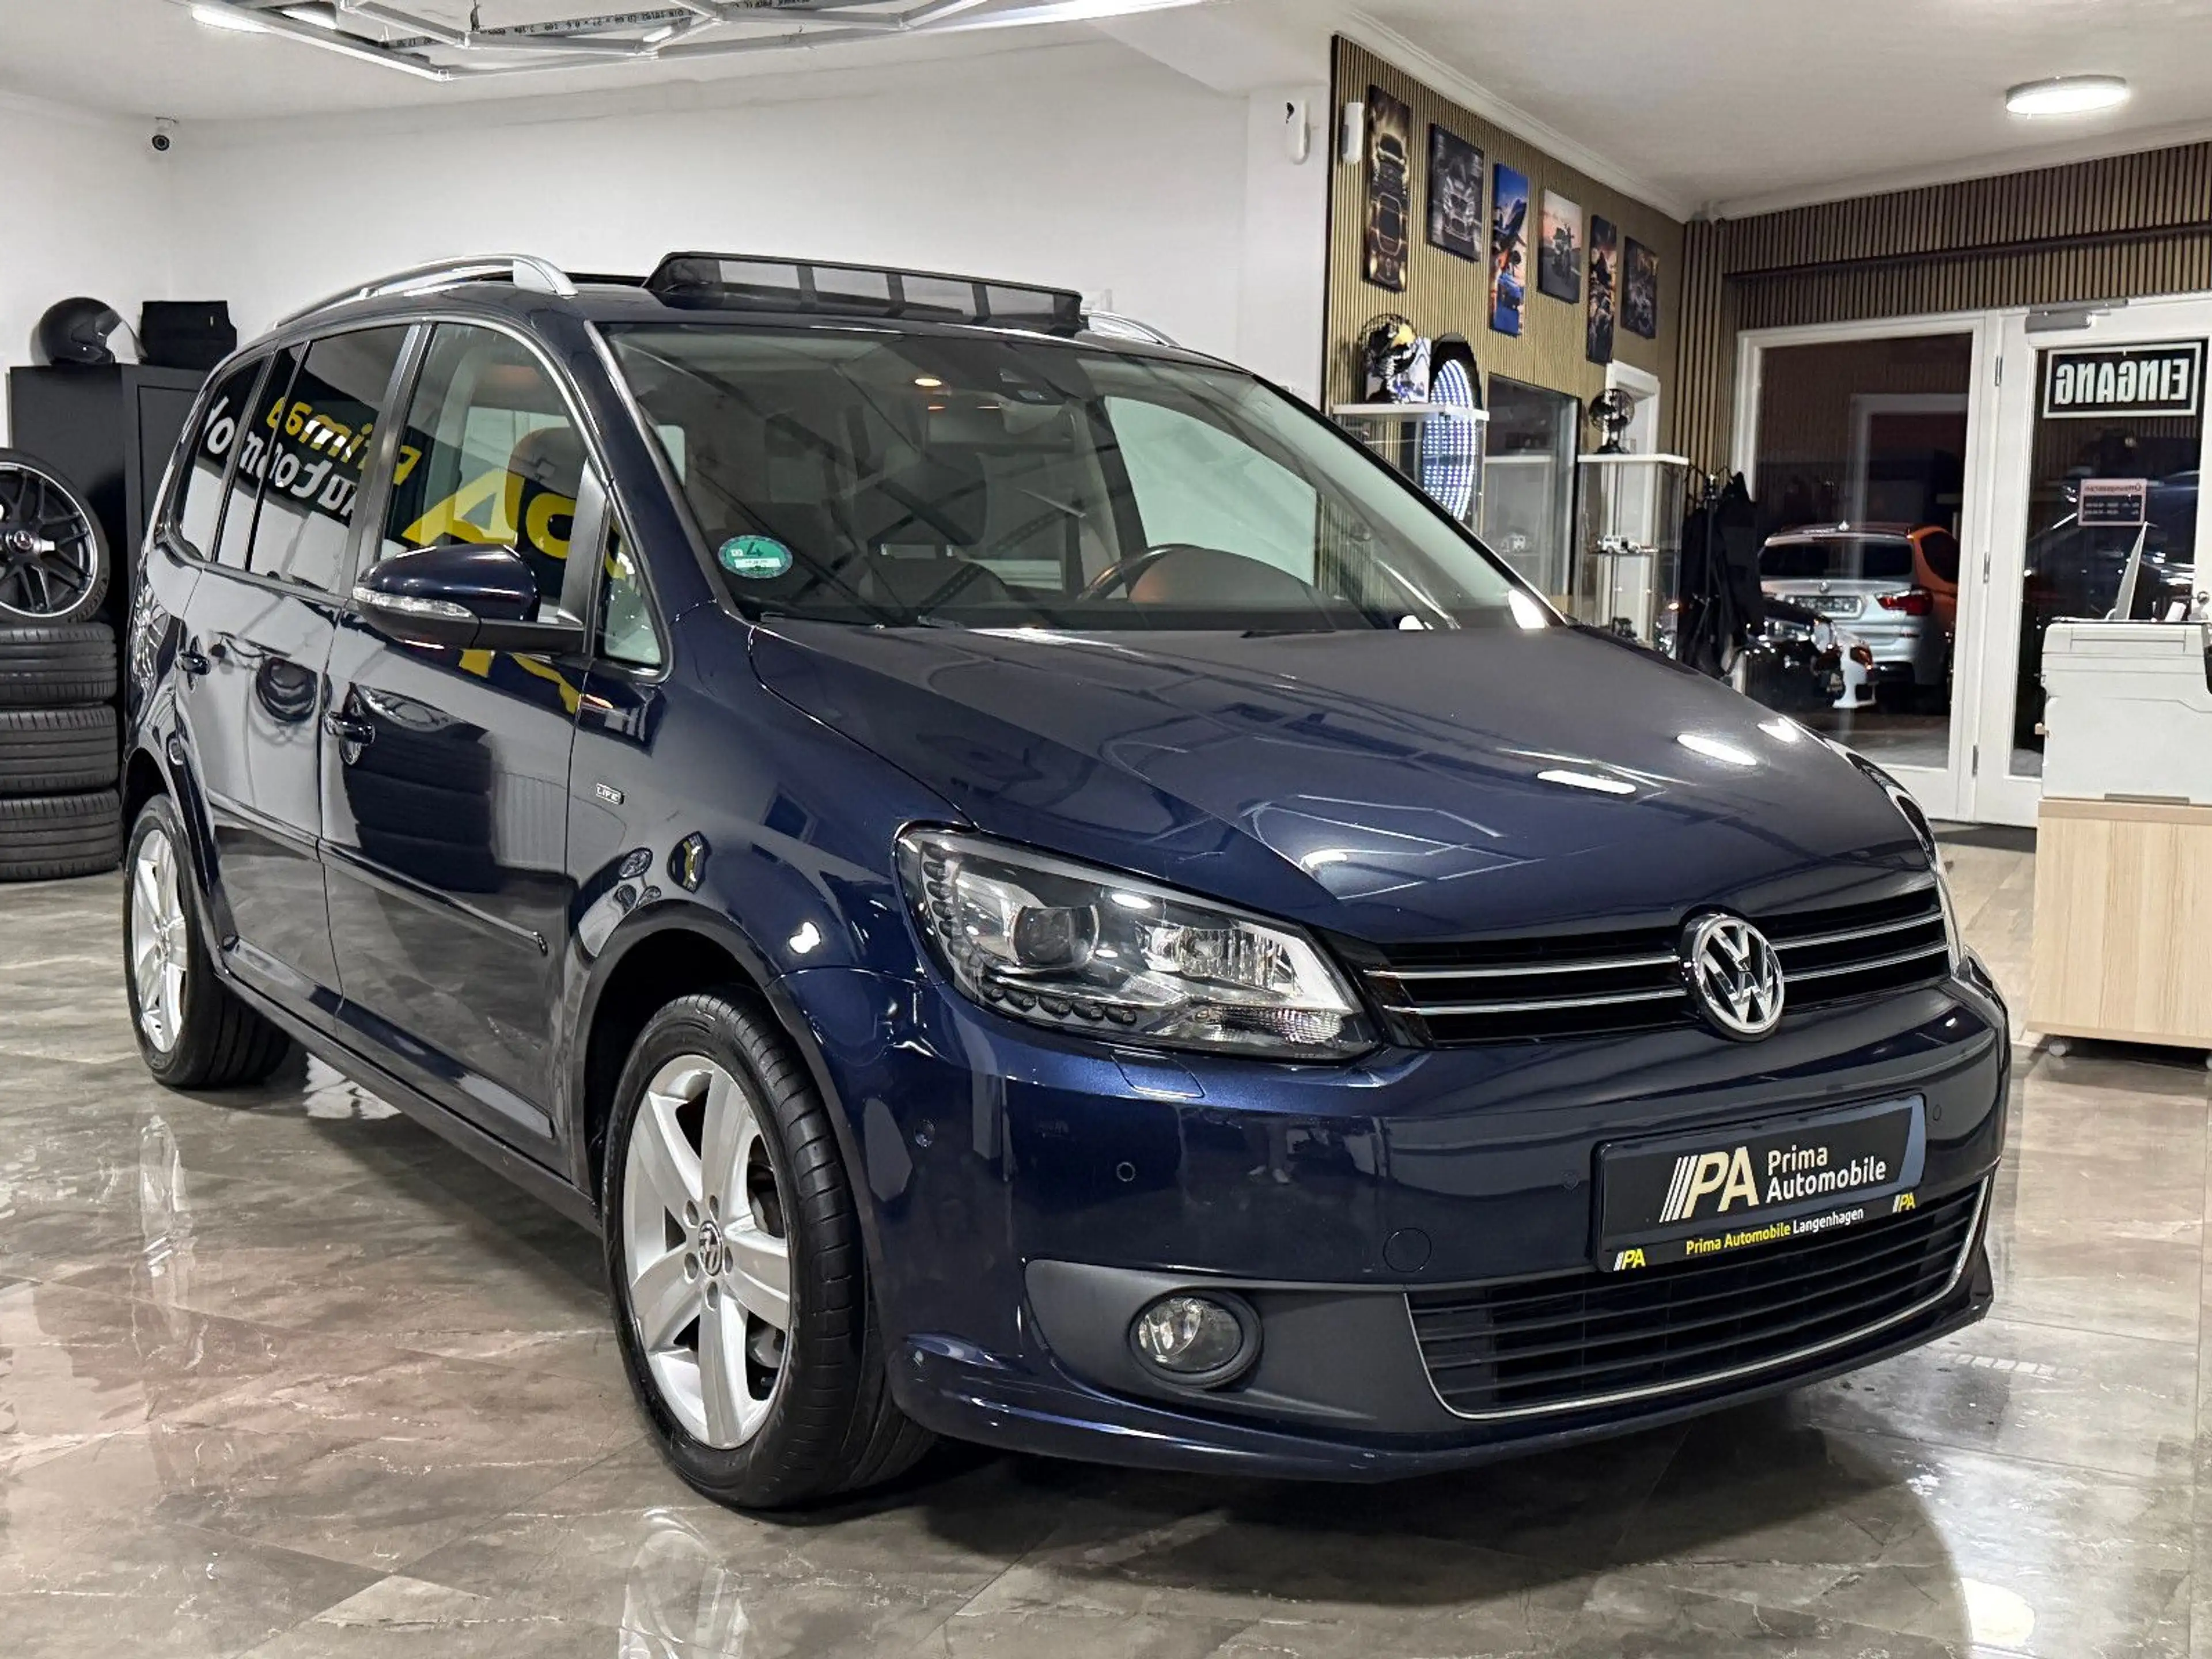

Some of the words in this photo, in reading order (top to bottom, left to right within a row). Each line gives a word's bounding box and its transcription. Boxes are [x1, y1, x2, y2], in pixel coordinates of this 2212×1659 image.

[747, 541, 764, 556] 4
[1766, 1156, 1887, 1204] Automobile
[1768, 1145, 1828, 1176] Prima
[1686, 1237, 1722, 1255] Prima
[1724, 1222, 1791, 1249] Automobile
[1793, 1208, 1864, 1235] Langenhagen
